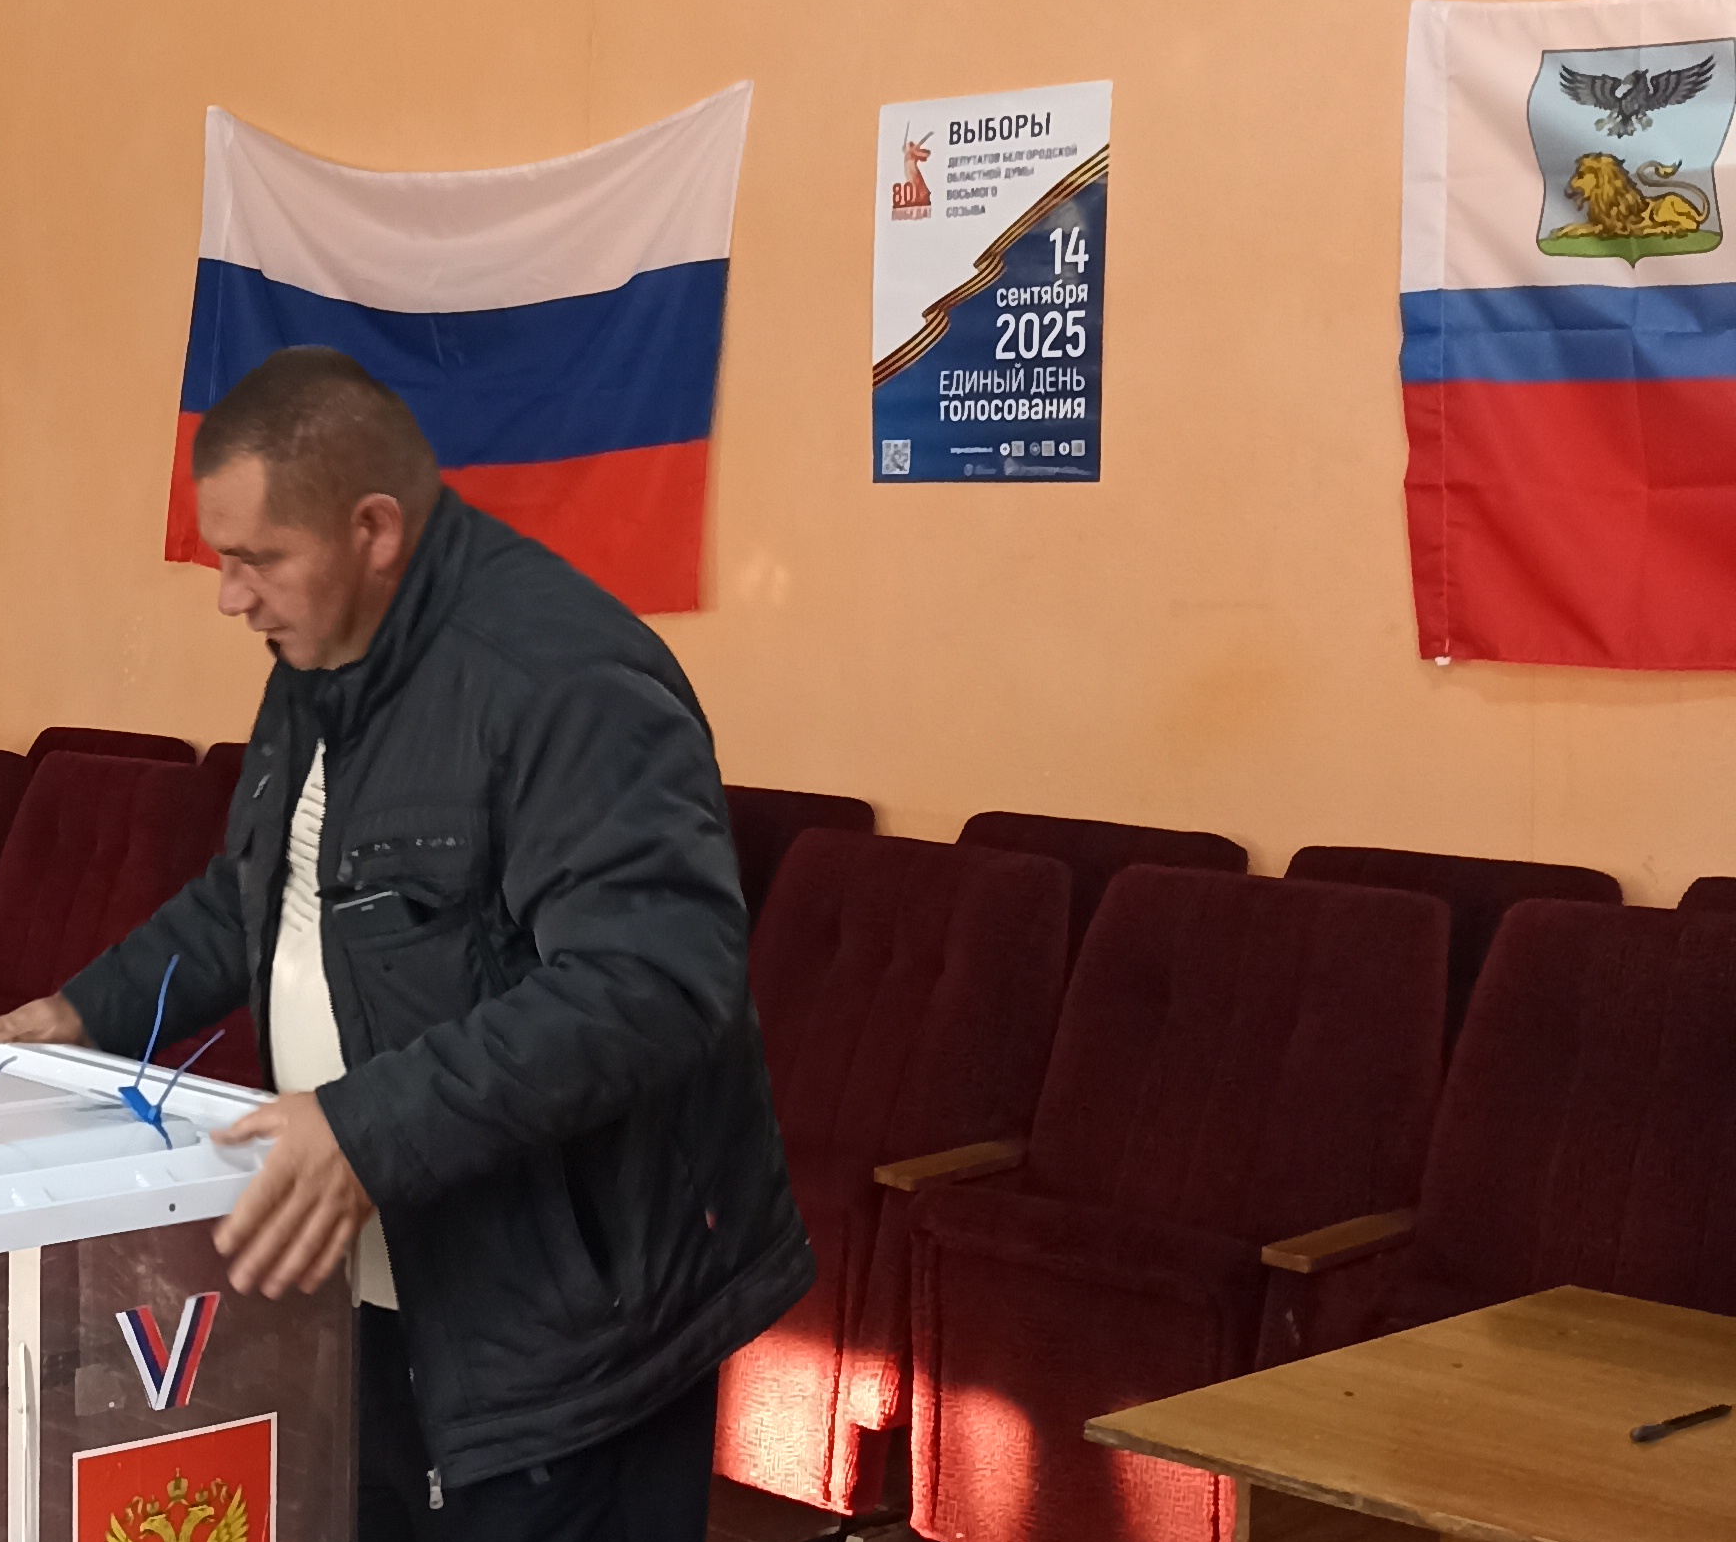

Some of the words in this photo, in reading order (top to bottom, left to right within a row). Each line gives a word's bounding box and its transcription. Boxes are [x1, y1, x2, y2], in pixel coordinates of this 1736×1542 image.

[948, 112, 1052, 145] ВЫБОРЫ
[1049, 226, 1090, 275] 14
[996, 279, 1089, 309] сентября
[995, 310, 1087, 360] 2025
[939, 362, 1025, 397] ЕДИНЫЙ
[1030, 366, 1086, 395] ДЕНЬ
[939, 397, 1086, 422] голосования
